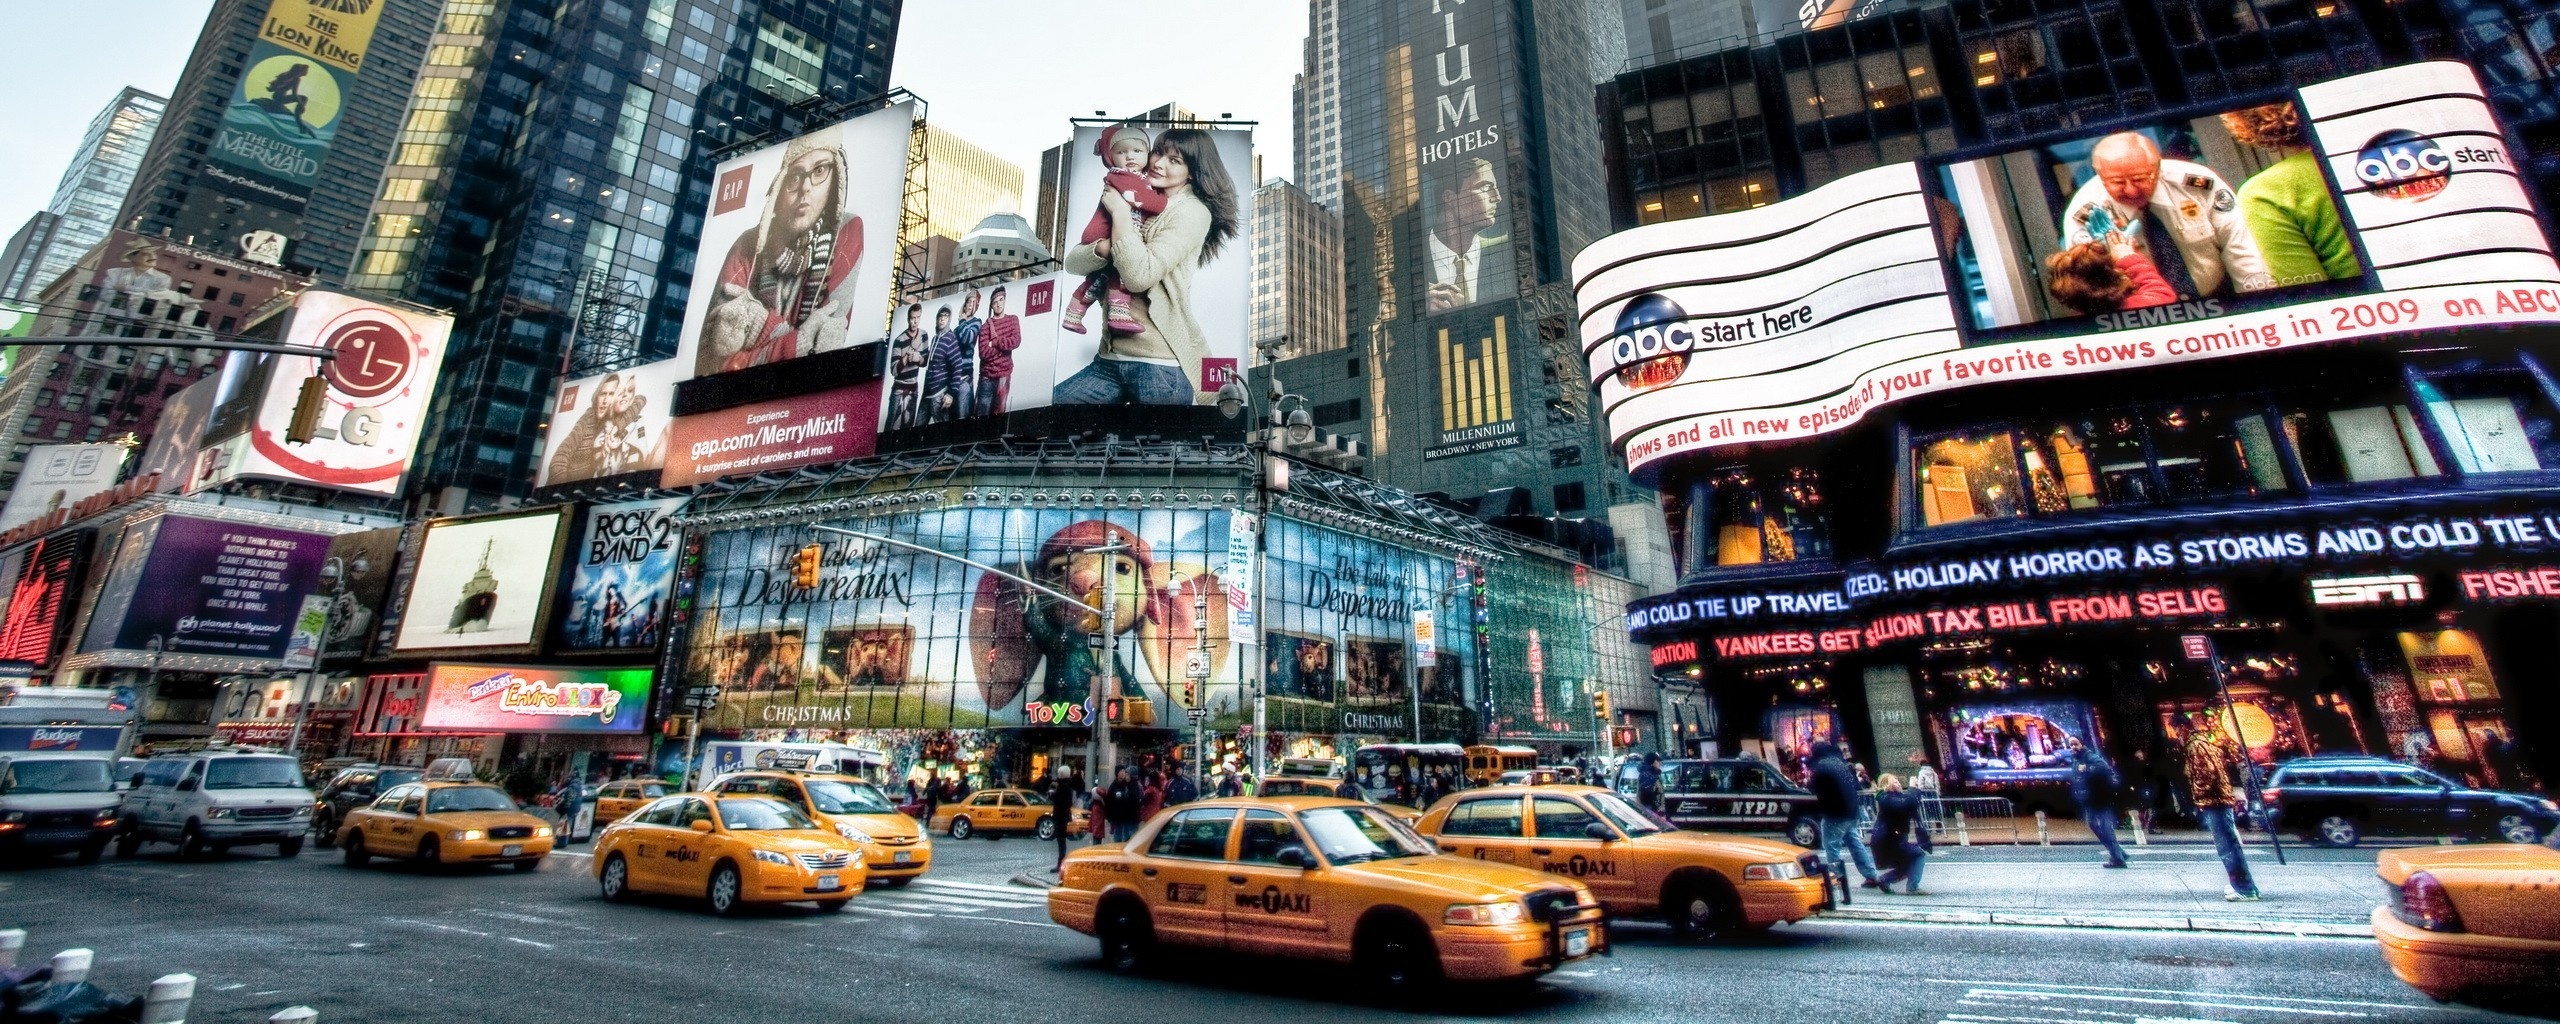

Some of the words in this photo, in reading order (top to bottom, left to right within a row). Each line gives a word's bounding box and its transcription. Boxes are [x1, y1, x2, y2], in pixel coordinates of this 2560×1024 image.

[308, 14, 339, 36] THE
[217, 131, 318, 177] MERMAID
[244, 132, 267, 147] THE
[270, 138, 304, 157] LITTLE
[1422, 125, 1499, 165] HOTELS
[2356, 146, 2449, 183] abc
[723, 180, 744, 201] GAP
[165, 244, 191, 256] 100%
[193, 251, 248, 271] Colombian
[250, 266, 283, 280] Coffee
[1031, 290, 1049, 307] GAP
[2095, 298, 2224, 332] SIEMENS
[1613, 317, 1693, 365] abc
[1702, 318, 1756, 343] start
[1762, 305, 1813, 336] here
[1629, 437, 1662, 464] shows
[1667, 423, 1700, 449] and
[1709, 418, 1735, 440] all
[1743, 417, 1789, 435] new
[1861, 379, 1874, 404] of
[1879, 368, 1932, 399] your
[1943, 348, 2052, 381] favorite
[2063, 340, 2156, 367] shows
[2166, 323, 2282, 356] coming
[2288, 314, 2321, 338] in
[2330, 298, 2419, 332] 2009
[2444, 298, 2485, 317] on
[747, 409, 790, 425] Experience
[691, 413, 846, 461] gap.com/MerryMixIt
[1443, 422, 1516, 444] MILLENNIUM
[695, 464, 702, 474] A
[702, 461, 733, 474] surprise
[733, 457, 751, 468] cast
[750, 455, 760, 465] of
[760, 450, 792, 464] carolers
[793, 447, 809, 459] and
[810, 444, 833, 456] more
[1426, 444, 1470, 459] BROADWAY
[1476, 440, 1495, 451] NEW
[1496, 436, 1520, 447] YORK
[231, 534, 247, 544] YOU
[247, 536, 268, 546] THINK
[593, 508, 658, 546] ROCK
[256, 548, 278, 558] MORE
[277, 551, 288, 559] TO
[586, 537, 650, 566] BAND
[651, 516, 670, 551] 2
[819, 538, 858, 568] Tale
[862, 535, 889, 574] of
[1893, 558, 2002, 591] HOLIDAY
[2010, 547, 2126, 579] HORROR
[2134, 542, 2175, 569] AS
[2182, 535, 2307, 564] STORMS
[2317, 528, 2384, 554] AND
[2391, 521, 2479, 550] COLD
[2483, 517, 2541, 543] TIE
[217, 555, 245, 565] PLANET
[236, 567, 261, 578] GREAT
[1332, 553, 1360, 584] The
[1362, 560, 1391, 589] Tale
[248, 580, 264, 589] GET
[263, 581, 280, 590] OUT
[278, 583, 290, 592] OF
[2311, 574, 2424, 605] ESPN
[1650, 603, 1691, 625] COLD
[1695, 599, 1727, 618] TIE
[1732, 596, 1761, 616] UP
[1766, 592, 1849, 614] TRAVEL
[1927, 607, 1983, 634] TAX
[1988, 602, 2047, 628] BILL
[2050, 595, 2132, 623] FROM
[2140, 587, 2227, 616] SELIG
[200, 618, 233, 630] planet
[233, 620, 282, 634] hollywood
[1715, 630, 1815, 658] YANKEES
[1819, 629, 1860, 652] GET
[763, 705, 852, 722] CHRISTMAS
[1344, 711, 1403, 729] CHRISTMAS
[33, 729, 83, 744] Budget
[1731, 801, 1778, 815] NYPD
[1569, 854, 1616, 877] TAXI
